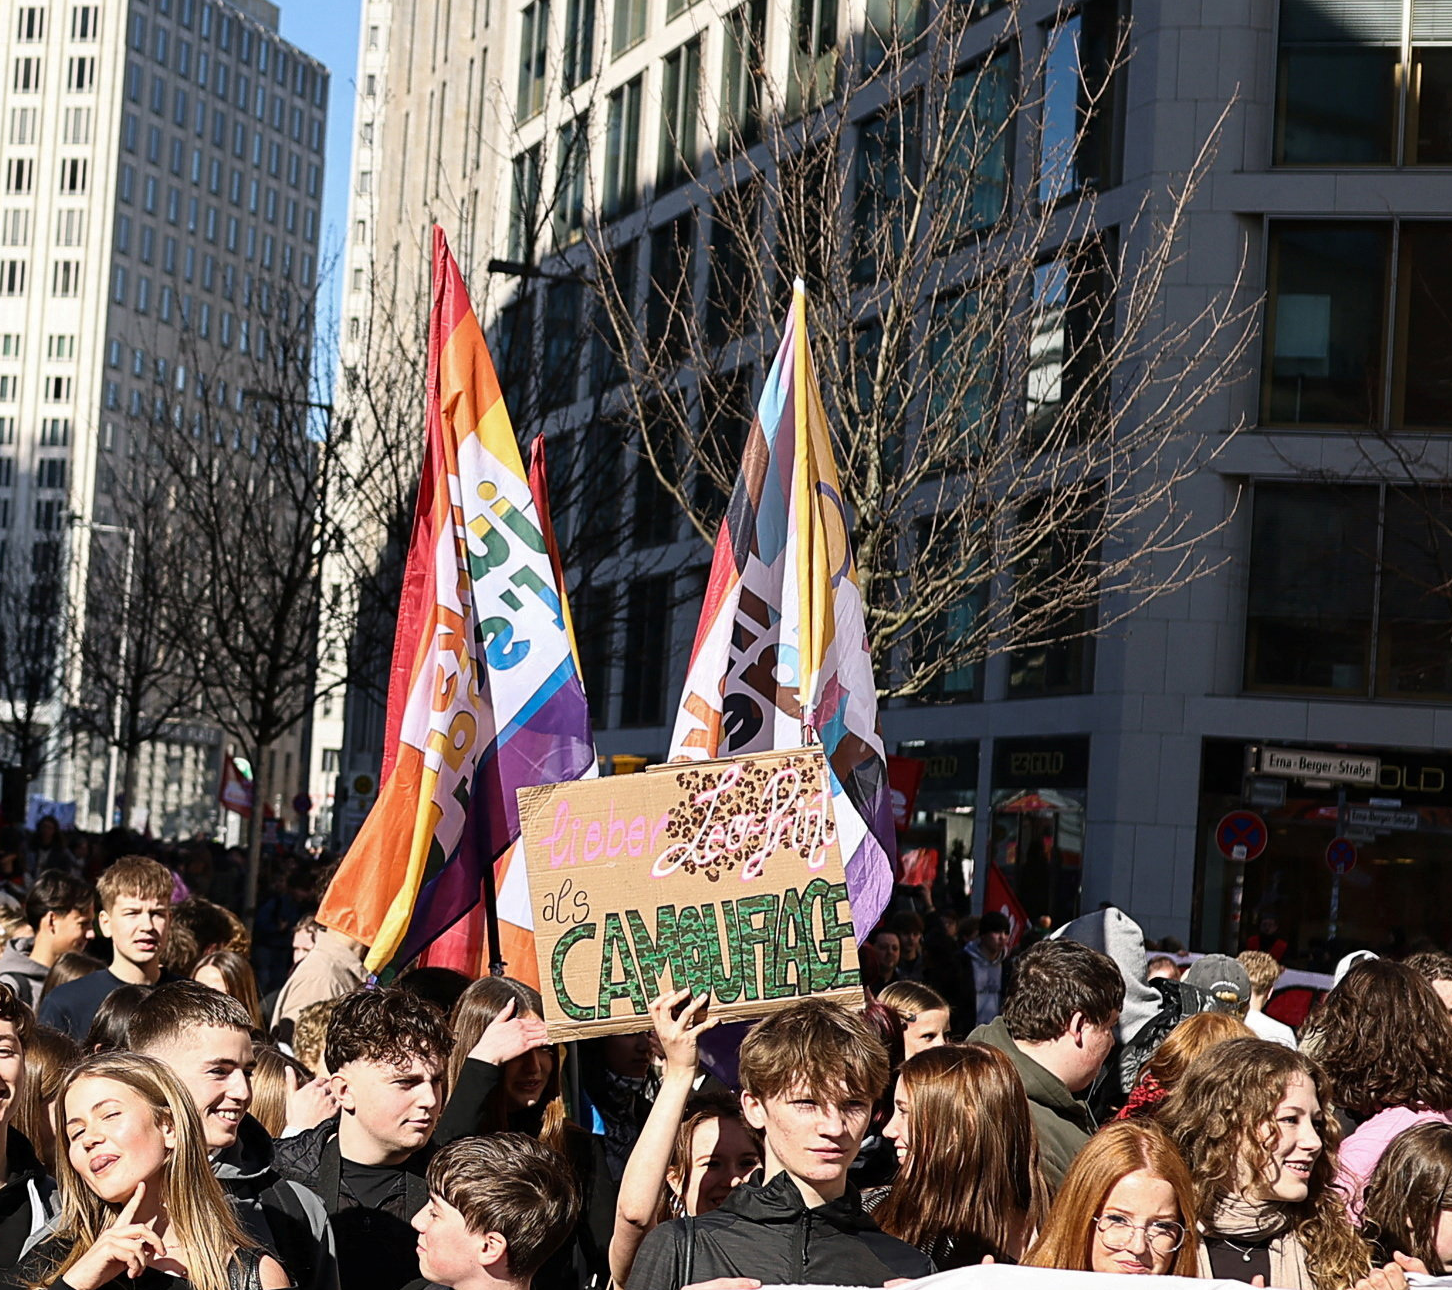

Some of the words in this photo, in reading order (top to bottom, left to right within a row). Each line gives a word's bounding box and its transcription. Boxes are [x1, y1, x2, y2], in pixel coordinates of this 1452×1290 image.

[540, 798, 670, 870] lieber
[542, 878, 590, 924] als
[551, 877, 863, 1021] CAMOUFLAGE
